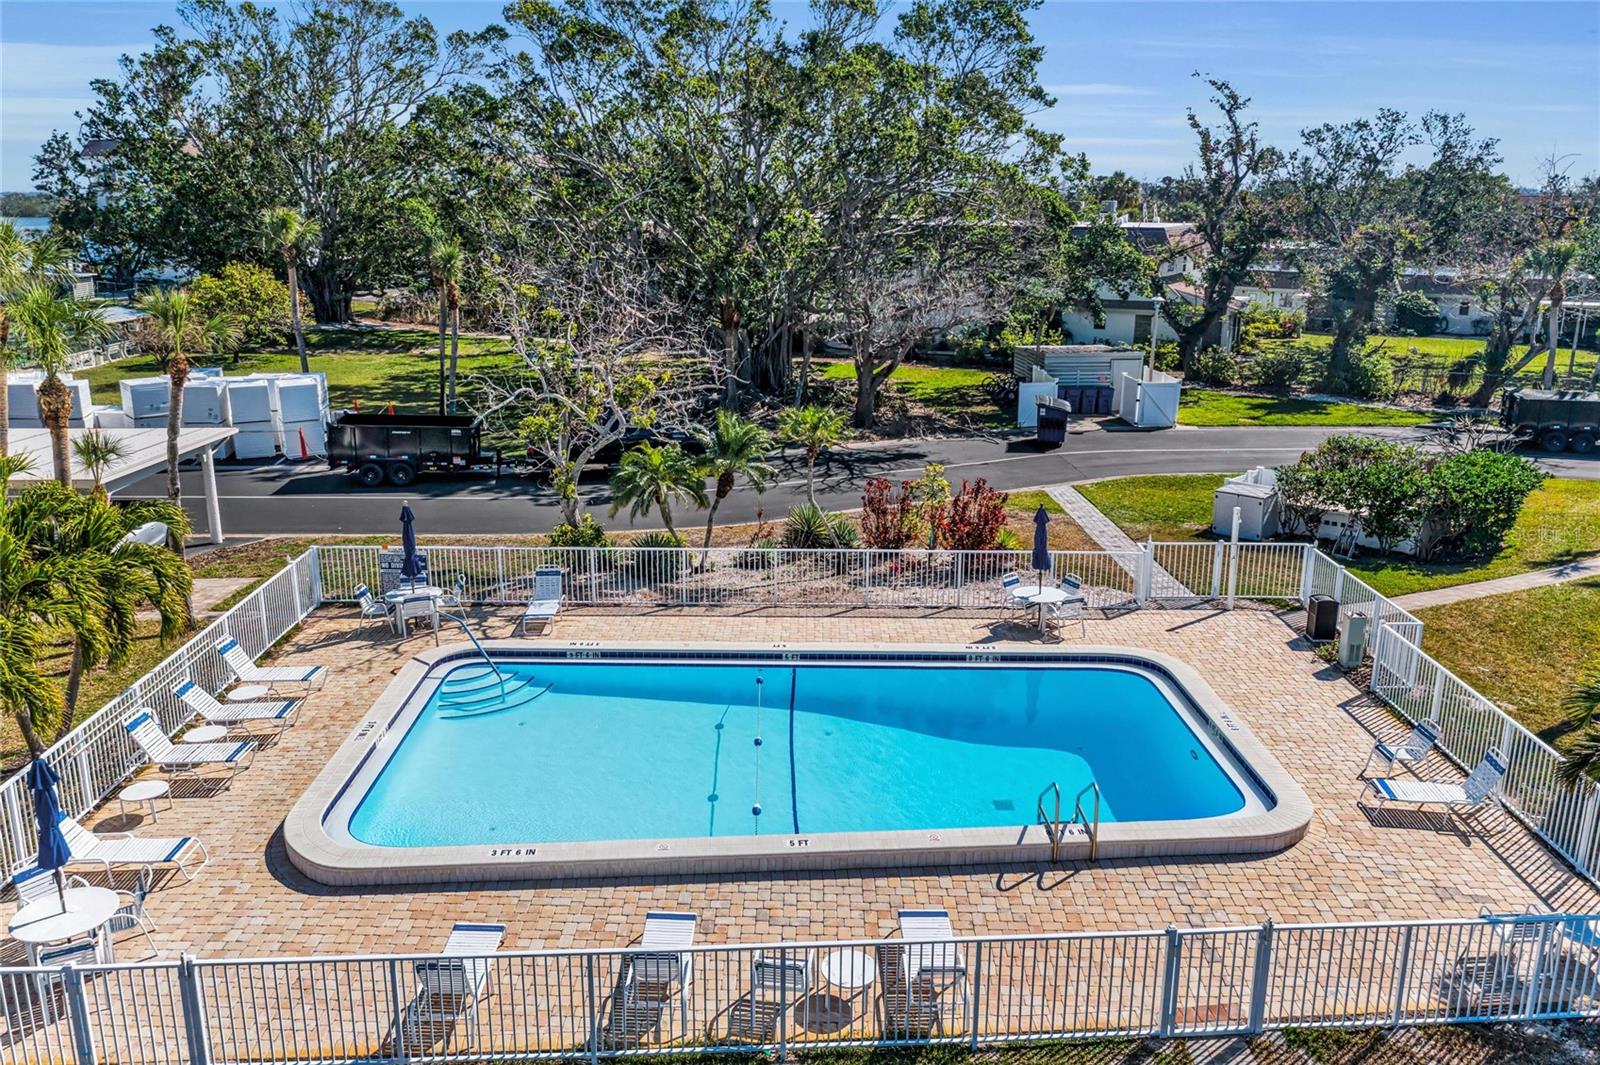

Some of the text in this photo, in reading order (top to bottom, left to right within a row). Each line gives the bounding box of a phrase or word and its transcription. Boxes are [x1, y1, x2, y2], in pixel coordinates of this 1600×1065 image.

[789, 839, 809, 847] 5 FT
[491, 849, 498, 857] 3
[525, 848, 536, 856] IN
